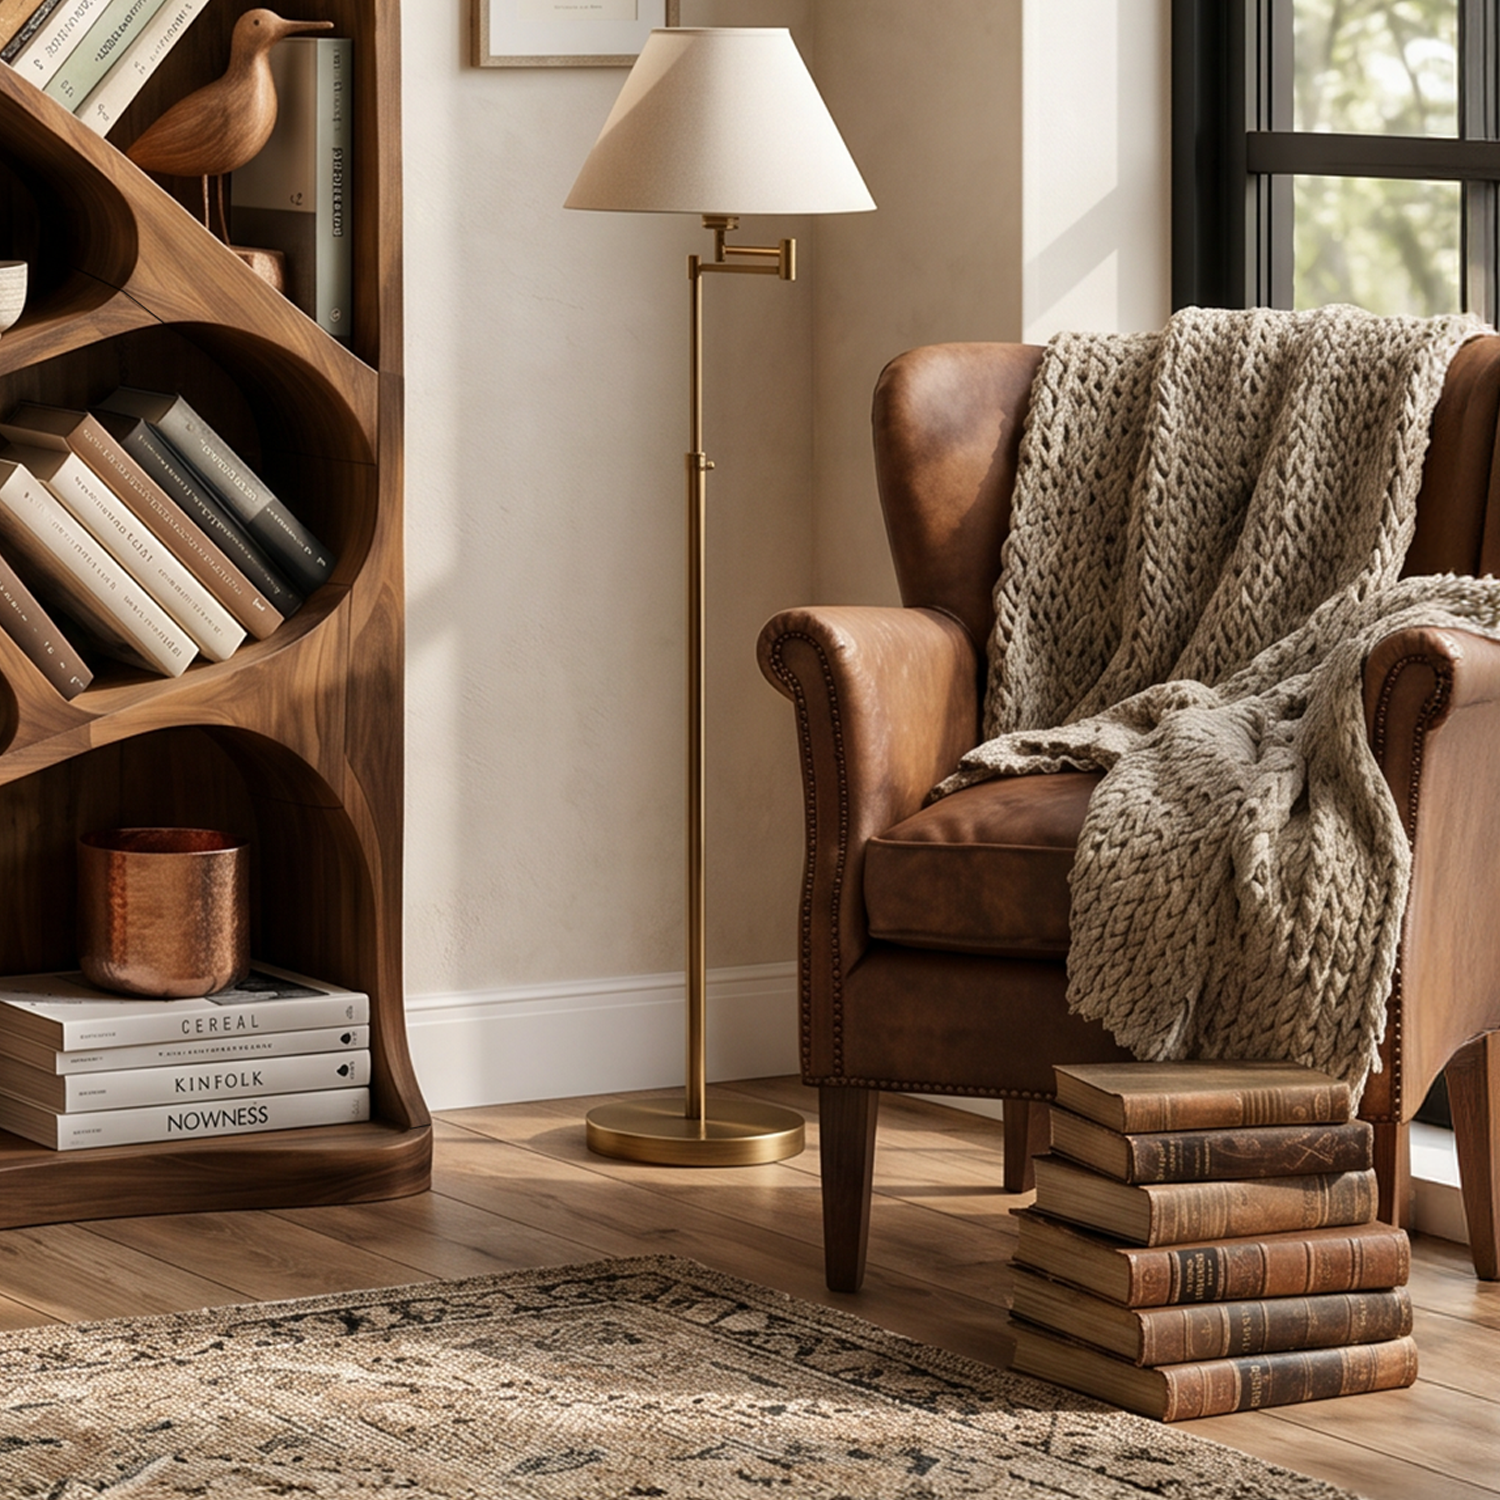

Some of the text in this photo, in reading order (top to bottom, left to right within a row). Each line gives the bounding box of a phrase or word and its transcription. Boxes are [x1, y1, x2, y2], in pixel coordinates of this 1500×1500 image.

[181, 1014, 259, 1035] CEREAL
[174, 1071, 264, 1093] KINFOLK
[166, 1105, 269, 1133] NOWNESS
